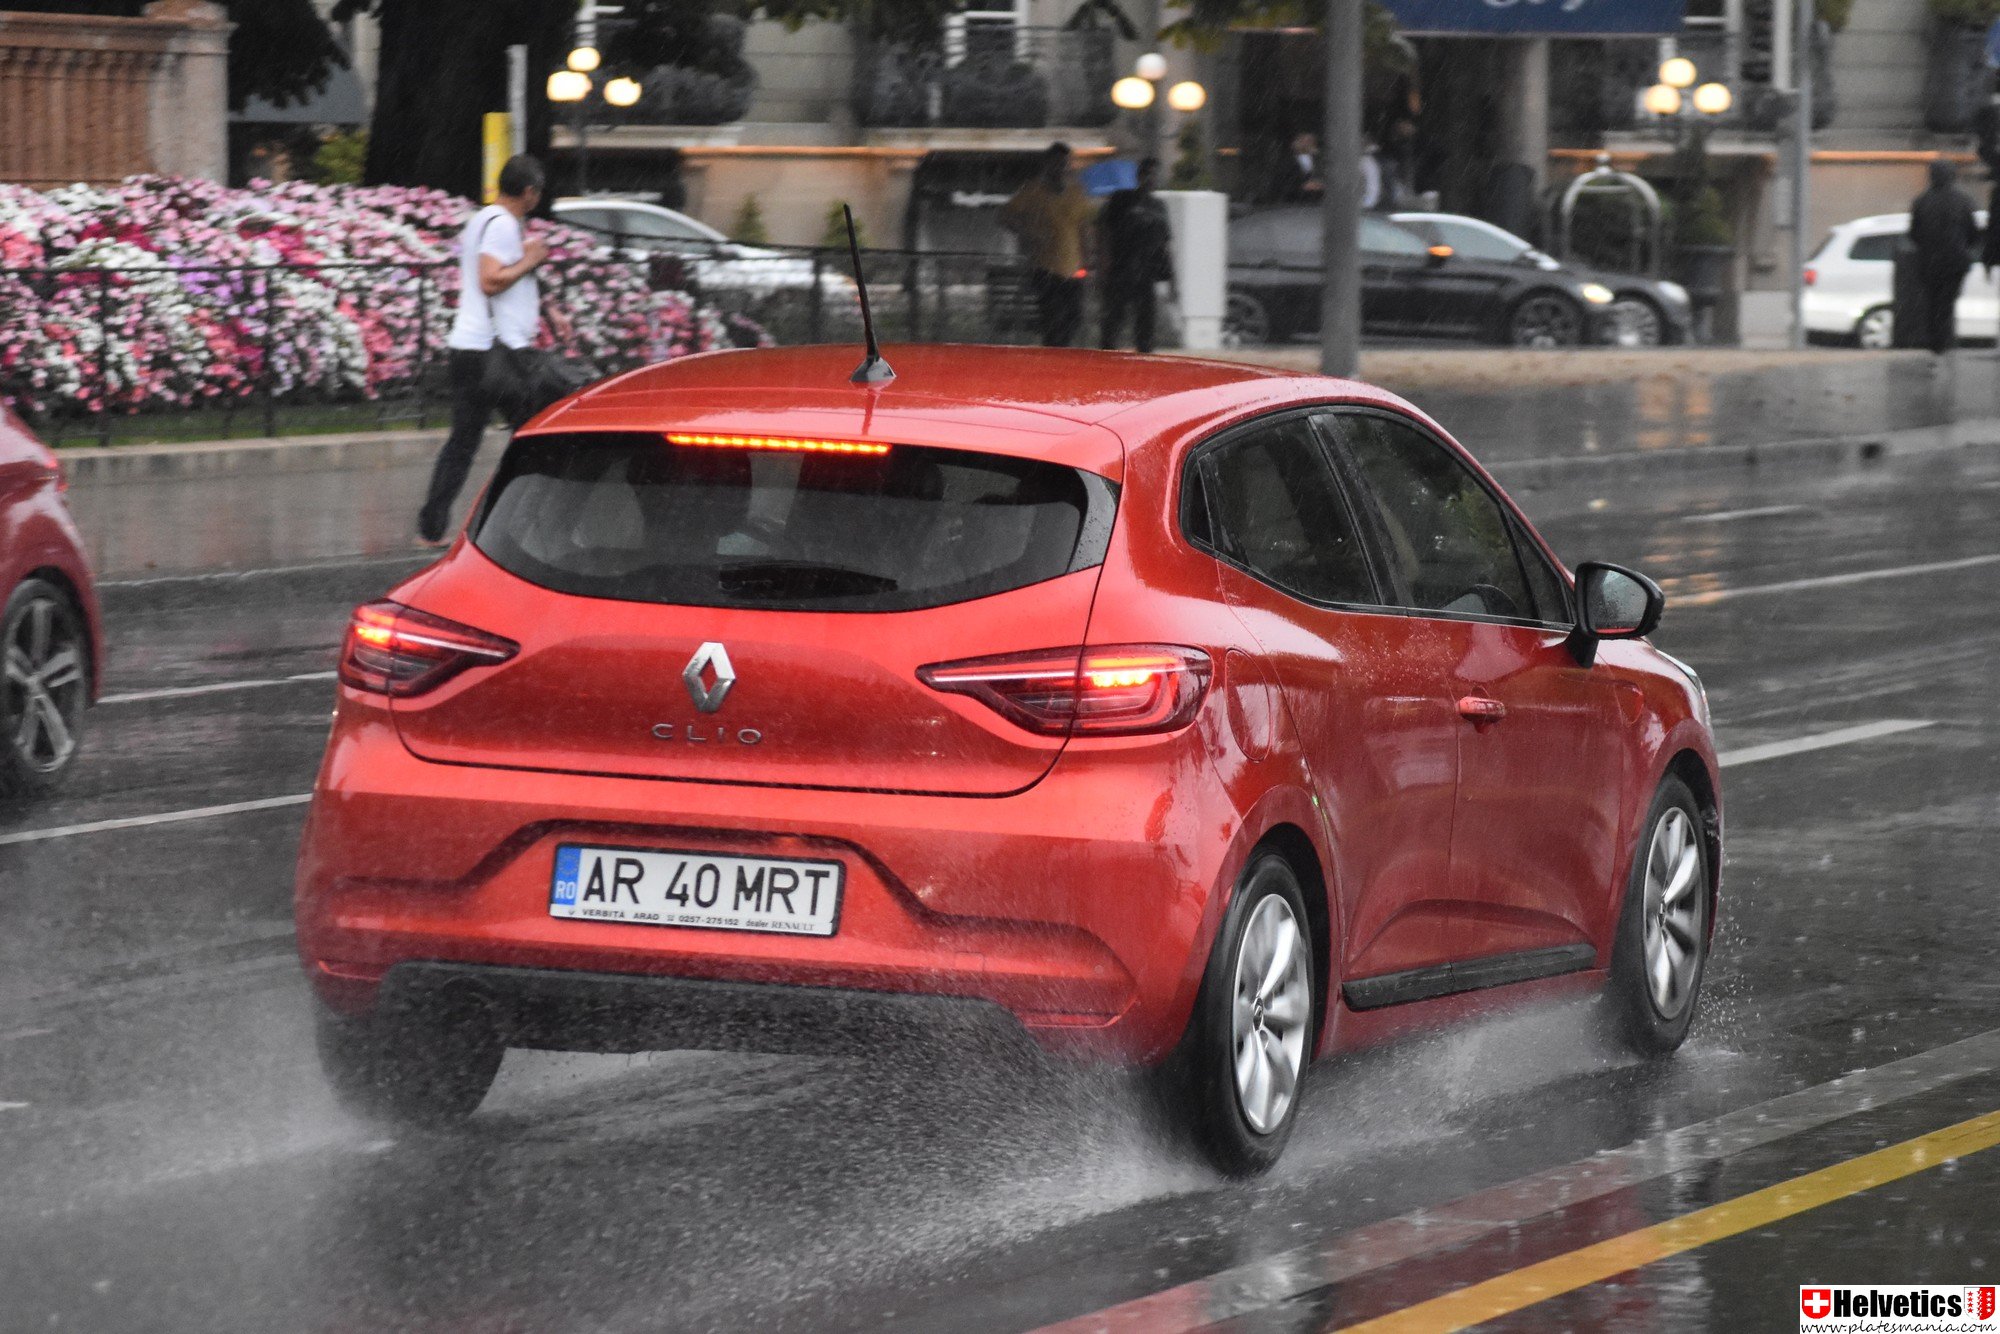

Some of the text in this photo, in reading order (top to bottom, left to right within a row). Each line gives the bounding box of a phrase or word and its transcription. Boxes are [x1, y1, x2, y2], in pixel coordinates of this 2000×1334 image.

[651, 723, 762, 744] CLIO
[555, 880, 576, 900] RO
[583, 856, 830, 916] AR 40 MRT
[633, 912, 660, 921] ARAD
[771, 922, 815, 932] RENAULT
